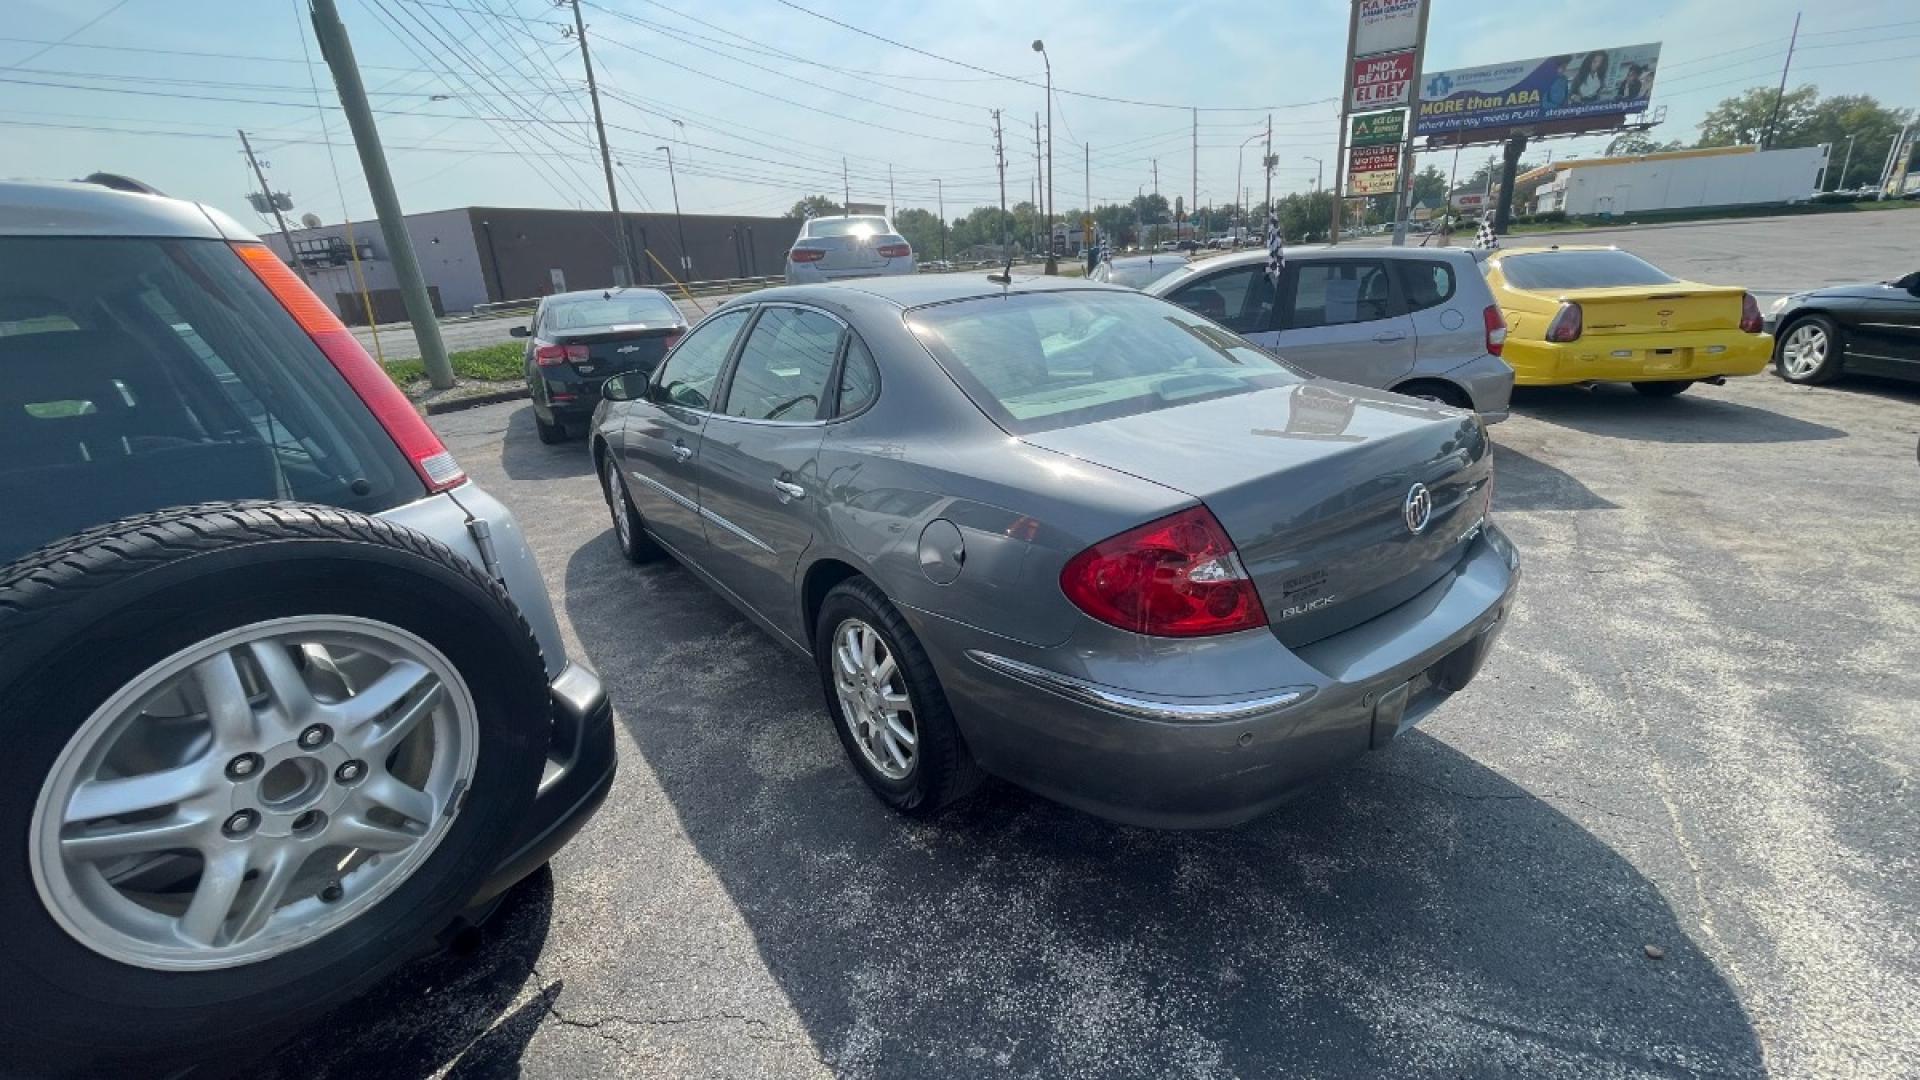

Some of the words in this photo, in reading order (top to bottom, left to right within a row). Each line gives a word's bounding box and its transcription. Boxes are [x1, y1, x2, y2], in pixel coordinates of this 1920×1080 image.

[1367, 58, 1399, 73] INDY
[1358, 68, 1407, 85] BEAUTY
[1357, 86, 1372, 102] EL
[1376, 80, 1405, 99] REY
[1420, 99, 1464, 115] MORE
[1467, 95, 1503, 110] than
[1507, 89, 1540, 105] ABA
[1352, 146, 1398, 157] AUGUSTA
[1354, 154, 1395, 165] MOTORS
[1282, 594, 1336, 619] BUICK
